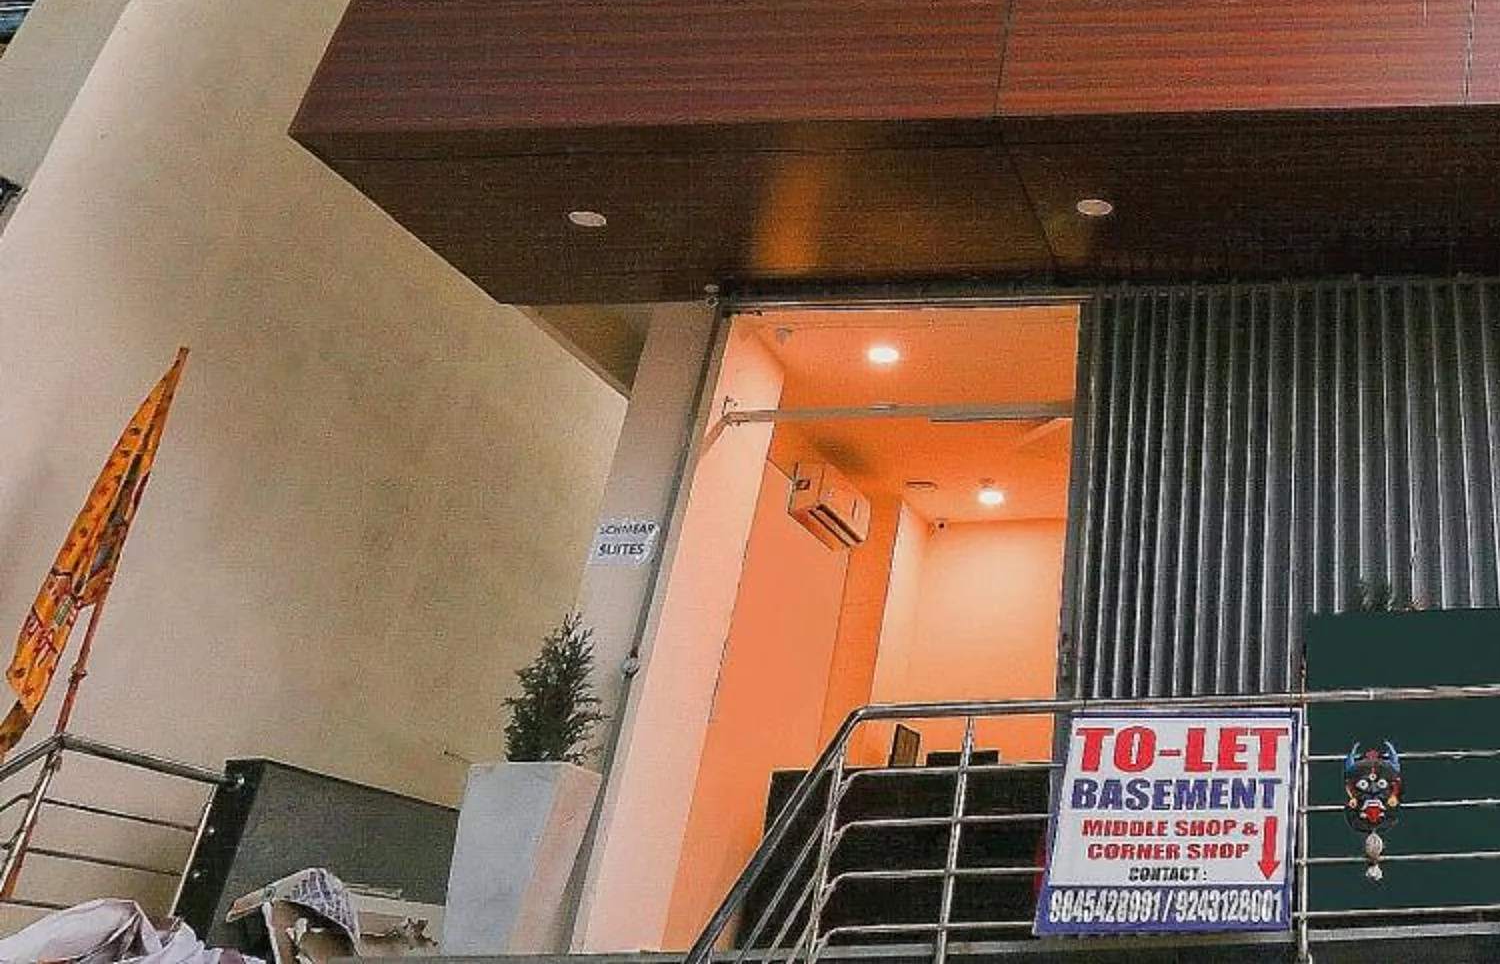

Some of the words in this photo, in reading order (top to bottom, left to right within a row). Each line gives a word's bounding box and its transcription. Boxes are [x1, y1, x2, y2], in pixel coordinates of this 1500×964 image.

[598, 543, 645, 556] SUITES
[1076, 726, 1289, 772] TO-LET
[1071, 778, 1282, 811] BASEMENT
[1082, 820, 1168, 837] MIDDLE
[1174, 819, 1236, 836] SHOP
[1242, 822, 1259, 836] &
[1087, 843, 1181, 860] CORNER
[1187, 843, 1249, 859] SHOP
